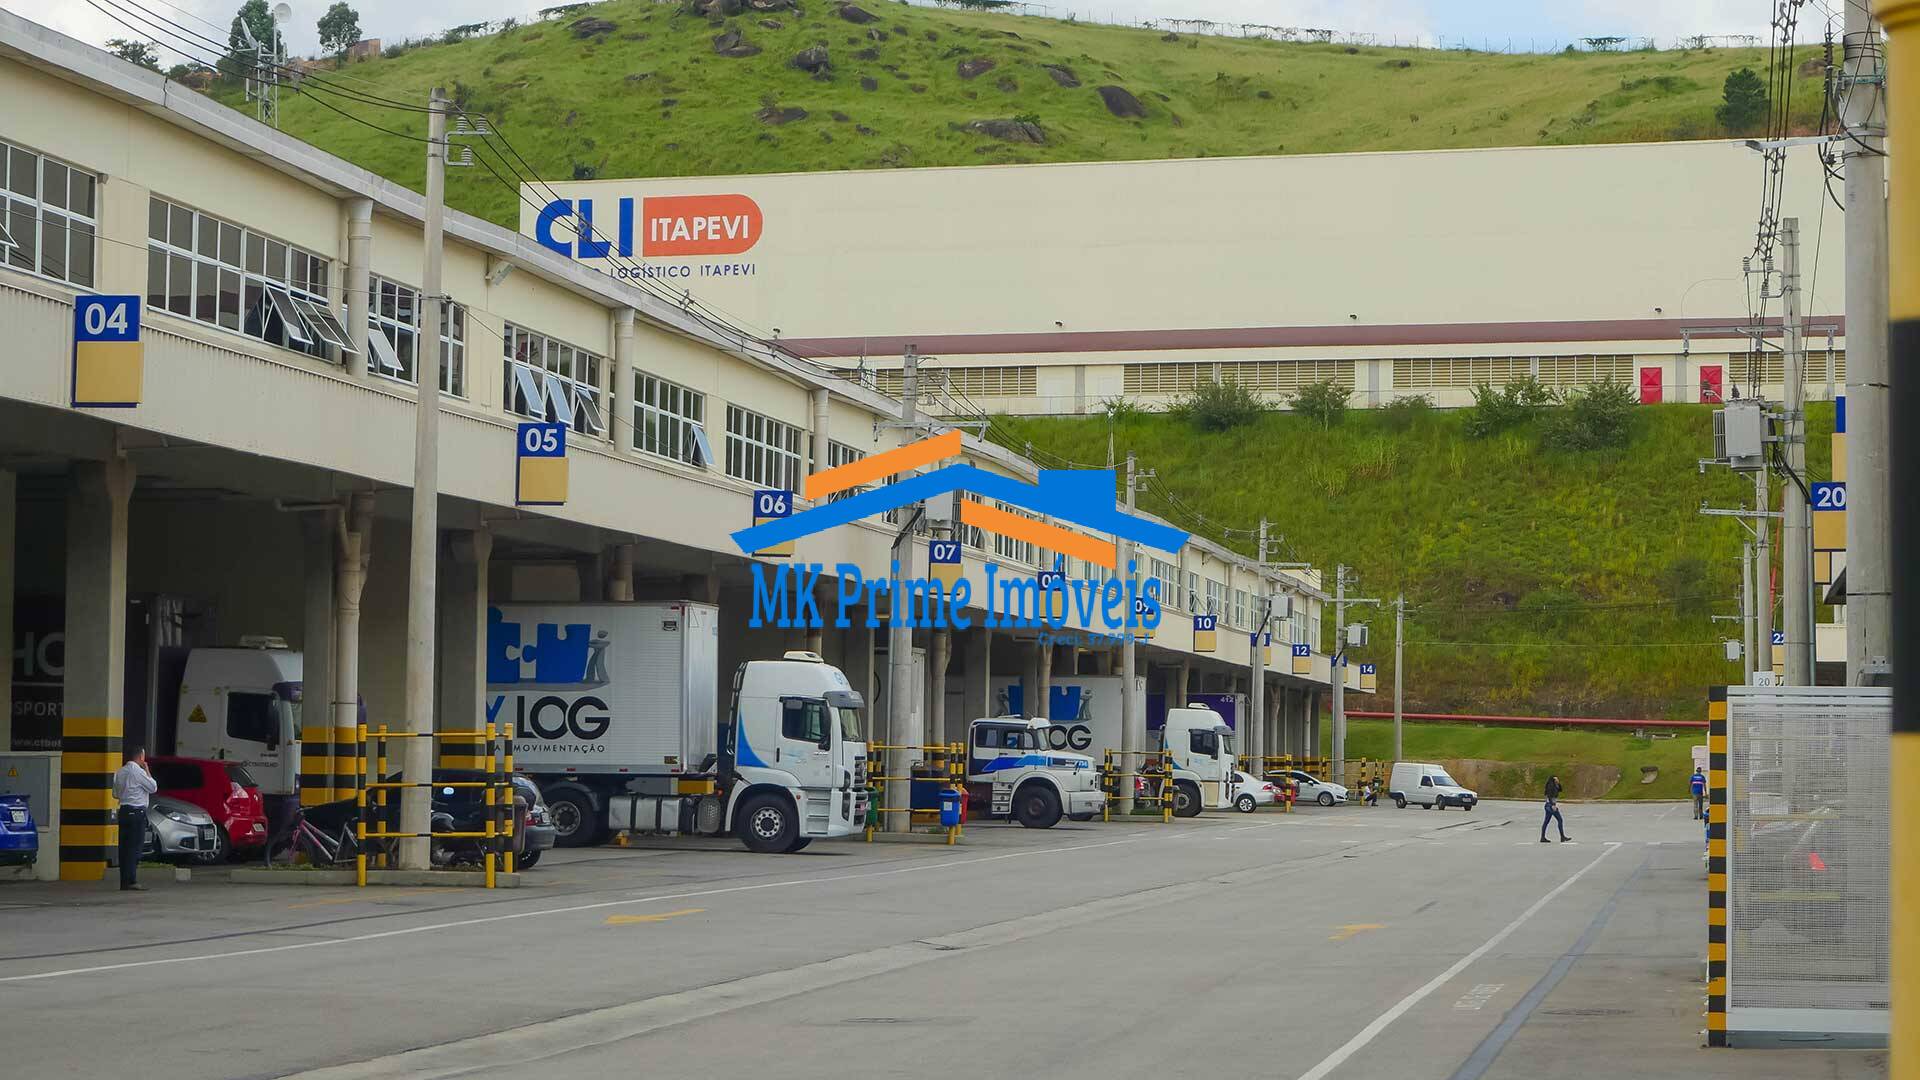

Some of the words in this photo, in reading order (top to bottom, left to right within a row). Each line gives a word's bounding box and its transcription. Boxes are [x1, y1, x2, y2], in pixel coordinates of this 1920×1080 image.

[536, 197, 634, 259] CLI
[650, 215, 749, 243] ITAPEVI
[610, 263, 691, 279] LOGÍSTICO
[700, 263, 756, 277] ITAPEVI
[83, 302, 130, 335] 04
[524, 427, 559, 453] 05
[759, 494, 787, 514] 06
[1817, 487, 1847, 507] 20
[933, 543, 957, 561] 07
[1197, 617, 1212, 629] 10
[1773, 633, 1785, 644] 2
[1295, 646, 1308, 656] 12
[1362, 664, 1374, 674] 14
[1758, 677, 1771, 687] 20
[516, 695, 611, 740] LOG
[513, 743, 606, 754] MOVIMENTAÇÃO
